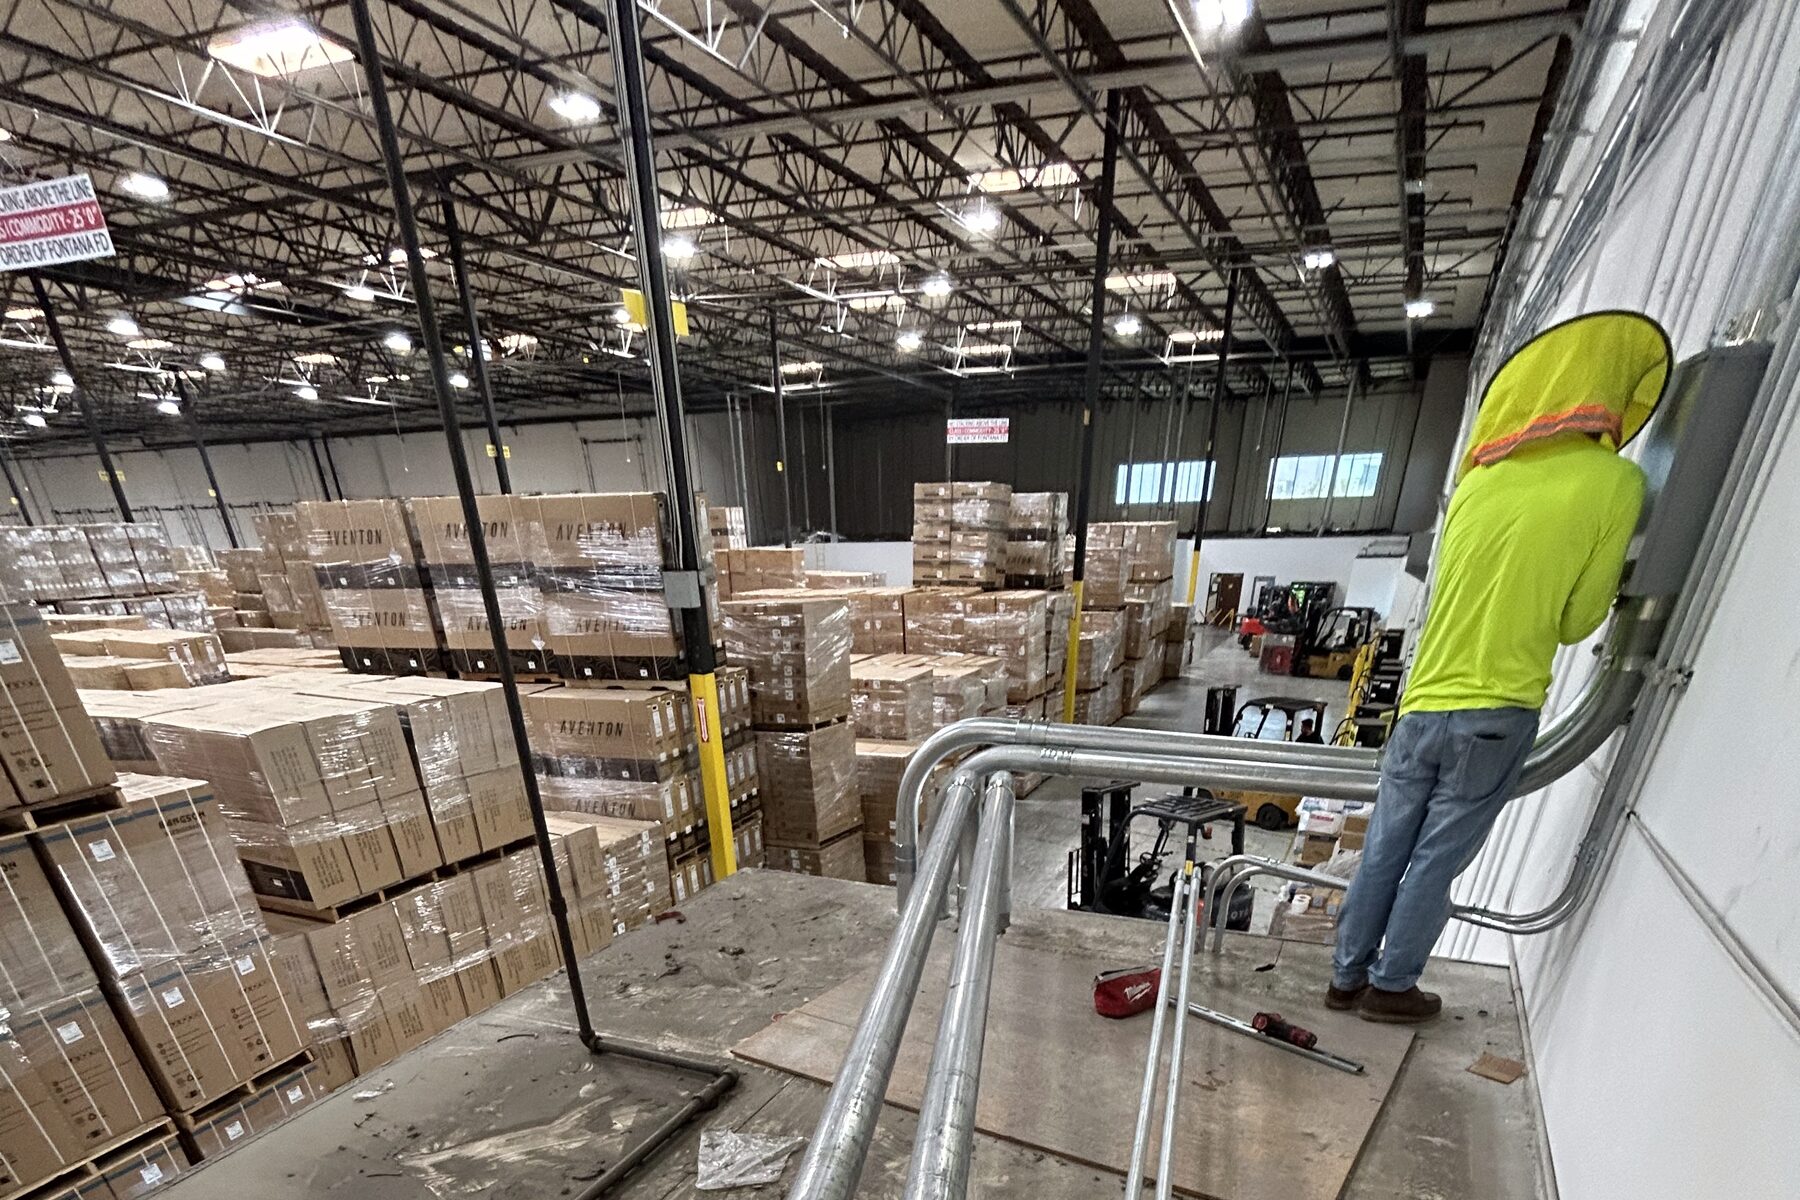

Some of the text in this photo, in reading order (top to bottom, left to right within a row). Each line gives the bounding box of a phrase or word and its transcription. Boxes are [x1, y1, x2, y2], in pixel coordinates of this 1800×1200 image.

[23, 186, 55, 208] ABOVE
[50, 182, 72, 202] THE
[69, 178, 93, 200] LINE
[0, 232, 110, 265] ORDER OF FONTANA FD
[445, 521, 508, 538] AVETON
[560, 720, 624, 737] AVENTON
[575, 799, 636, 817] AVENTON
